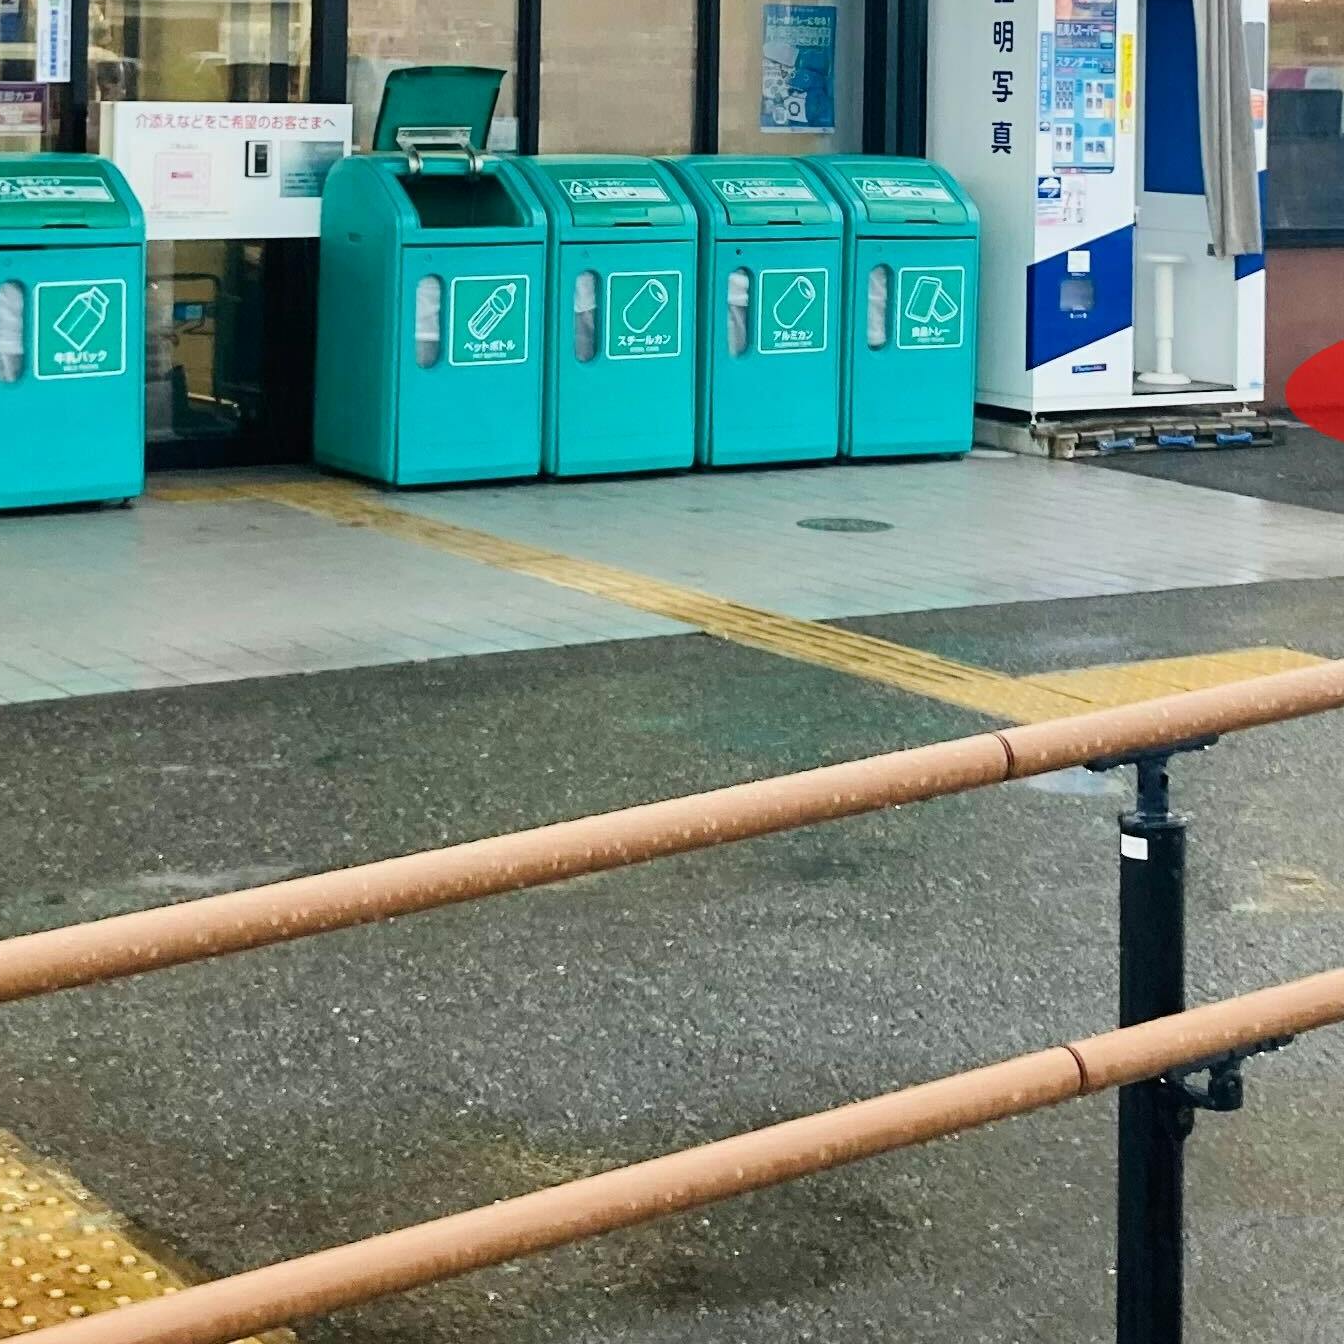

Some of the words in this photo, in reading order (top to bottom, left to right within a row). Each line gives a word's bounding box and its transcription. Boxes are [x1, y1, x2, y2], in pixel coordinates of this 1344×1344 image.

[135, 113, 337, 129] 介添えなどをご希望のお客さまへ
[617, 334, 671, 346] スチールカン
[773, 330, 814, 341] アルミカン
[464, 340, 516, 352] ペットボトル
